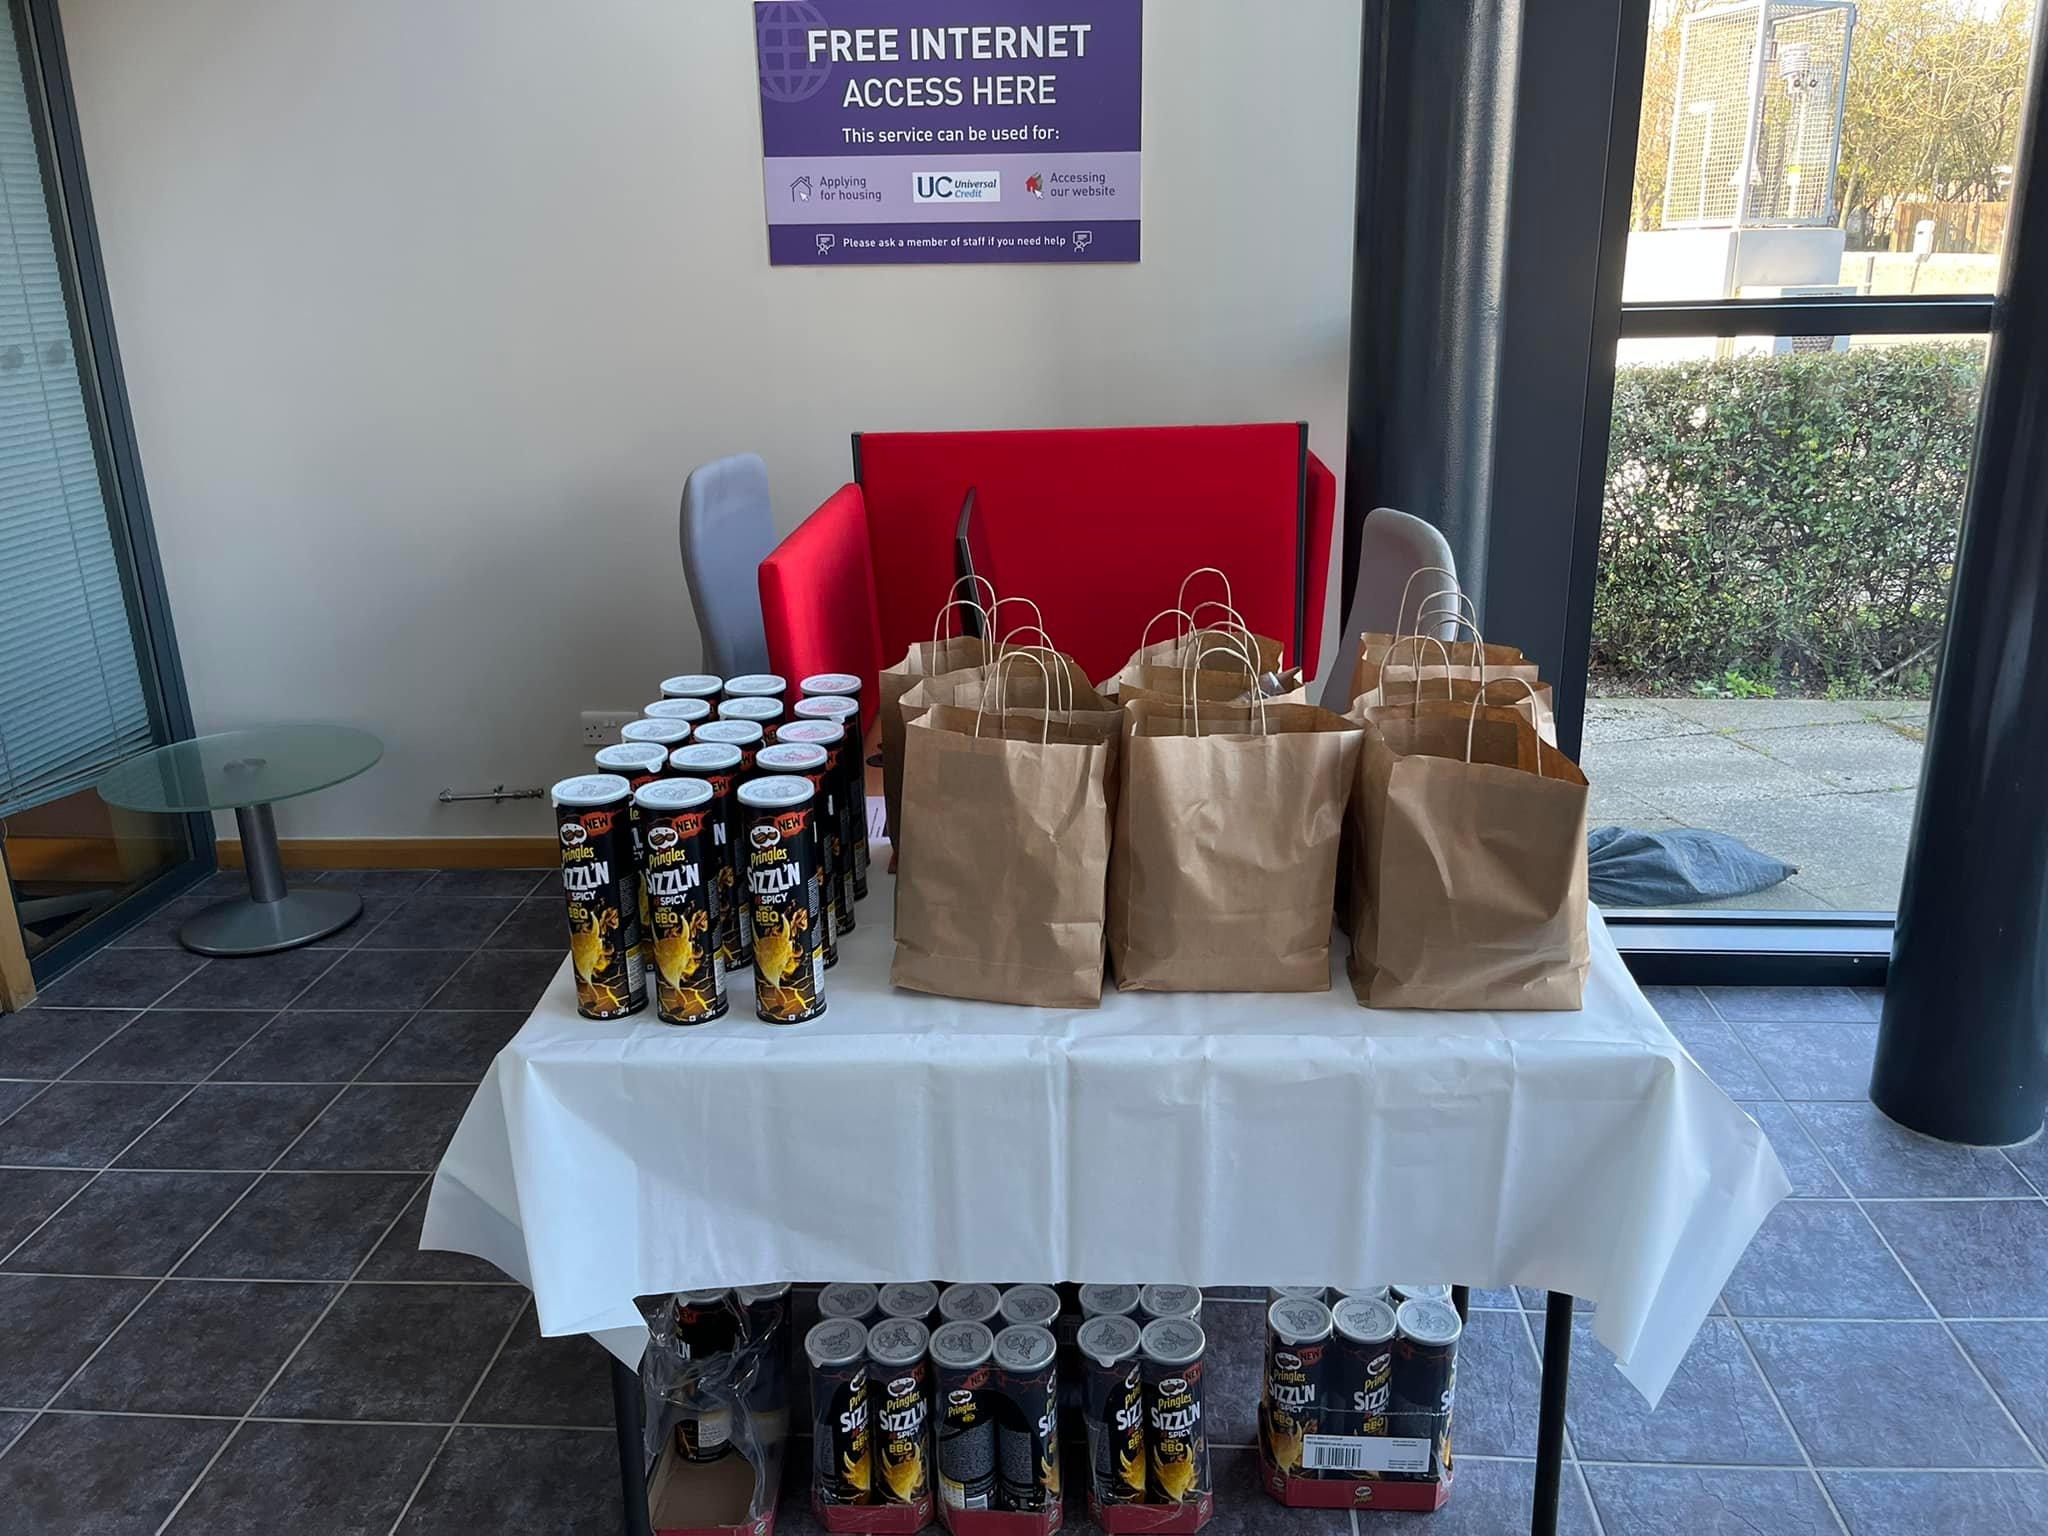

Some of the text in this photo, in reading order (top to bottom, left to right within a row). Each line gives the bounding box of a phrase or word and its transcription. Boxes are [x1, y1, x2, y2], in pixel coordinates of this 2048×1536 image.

[807, 24, 1092, 62] FREE INTERNET
[842, 75, 1057, 108] ACCESS HERE
[842, 125, 1060, 143] This service can be used for:
[820, 176, 866, 188] Applying
[954, 179, 997, 189] Universal
[1050, 172, 1106, 184] Accessing
[917, 176, 953, 198] UC
[954, 189, 982, 198] Credit
[1050, 185, 1116, 197] our website
[820, 189, 882, 202] for housing
[843, 236, 1066, 248] Please ask a member of staff if you need help
[712, 779, 728, 793] EW
[585, 816, 609, 831] NEW
[675, 817, 700, 832] NEW
[779, 816, 801, 832] NEW
[649, 847, 686, 869] Pringles
[751, 846, 788, 869] Pringles
[562, 861, 610, 891] IZZL'N
[747, 862, 801, 894] SIZZL'N
[572, 891, 596, 902] SPICY
[660, 893, 688, 906] SPICY
[761, 892, 788, 905] SPICY
[655, 912, 679, 924] BBQ
[755, 910, 780, 922] BBQ
[1273, 1369, 1306, 1383] Pringles
[887, 1391, 920, 1412] Pringles
[1158, 1393, 1192, 1411] Pringles
[948, 1402, 977, 1418] Pringles
[889, 1442, 912, 1454] BBQ
[1161, 1442, 1184, 1452] BBQ
